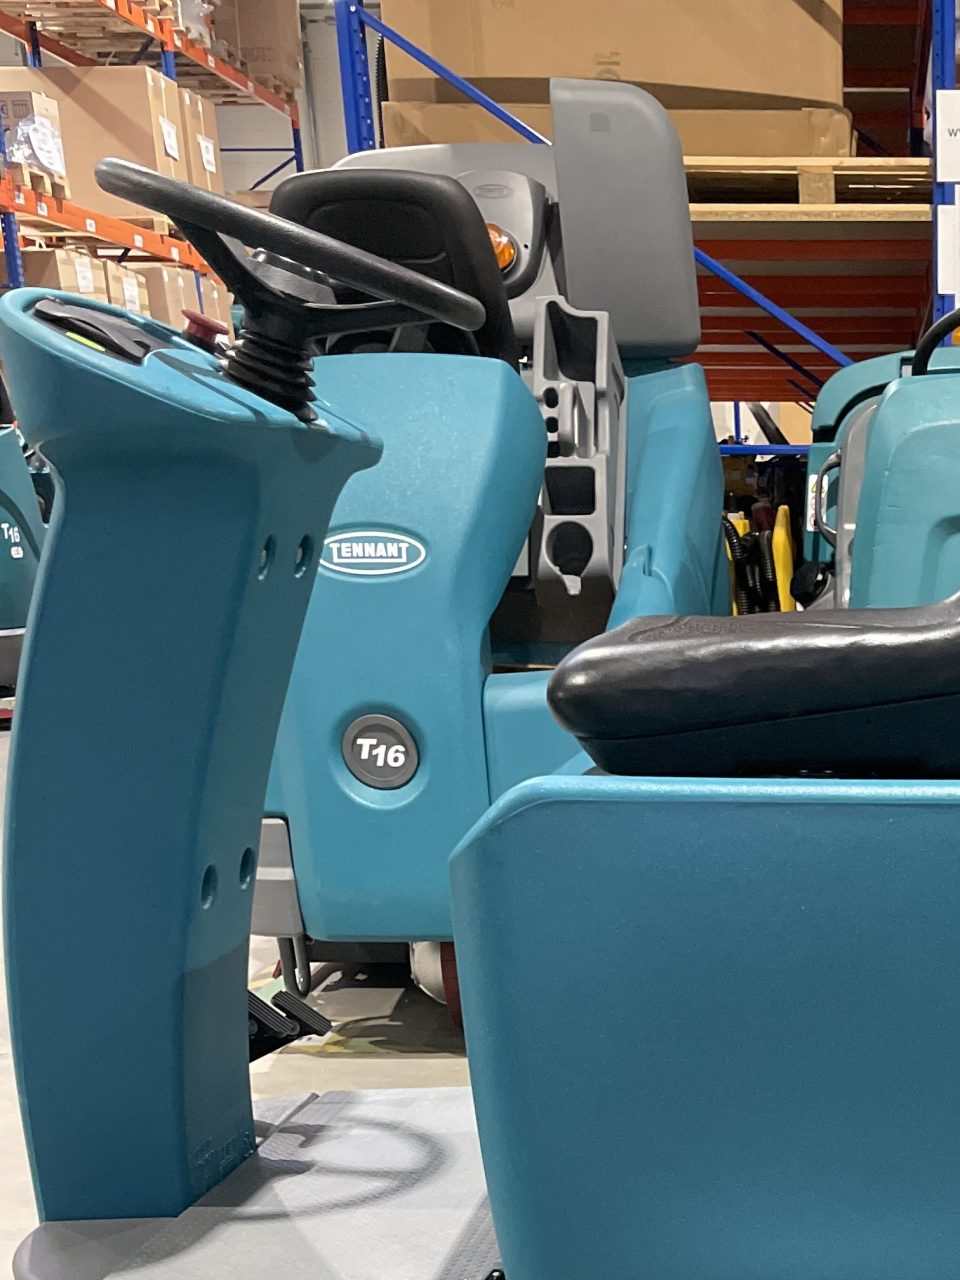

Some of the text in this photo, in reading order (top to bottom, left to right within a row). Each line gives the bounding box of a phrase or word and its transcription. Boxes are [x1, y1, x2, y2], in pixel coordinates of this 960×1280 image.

[1, 522, 21, 544] T16
[329, 542, 410, 563] TENNANT
[356, 738, 406, 768] T16
